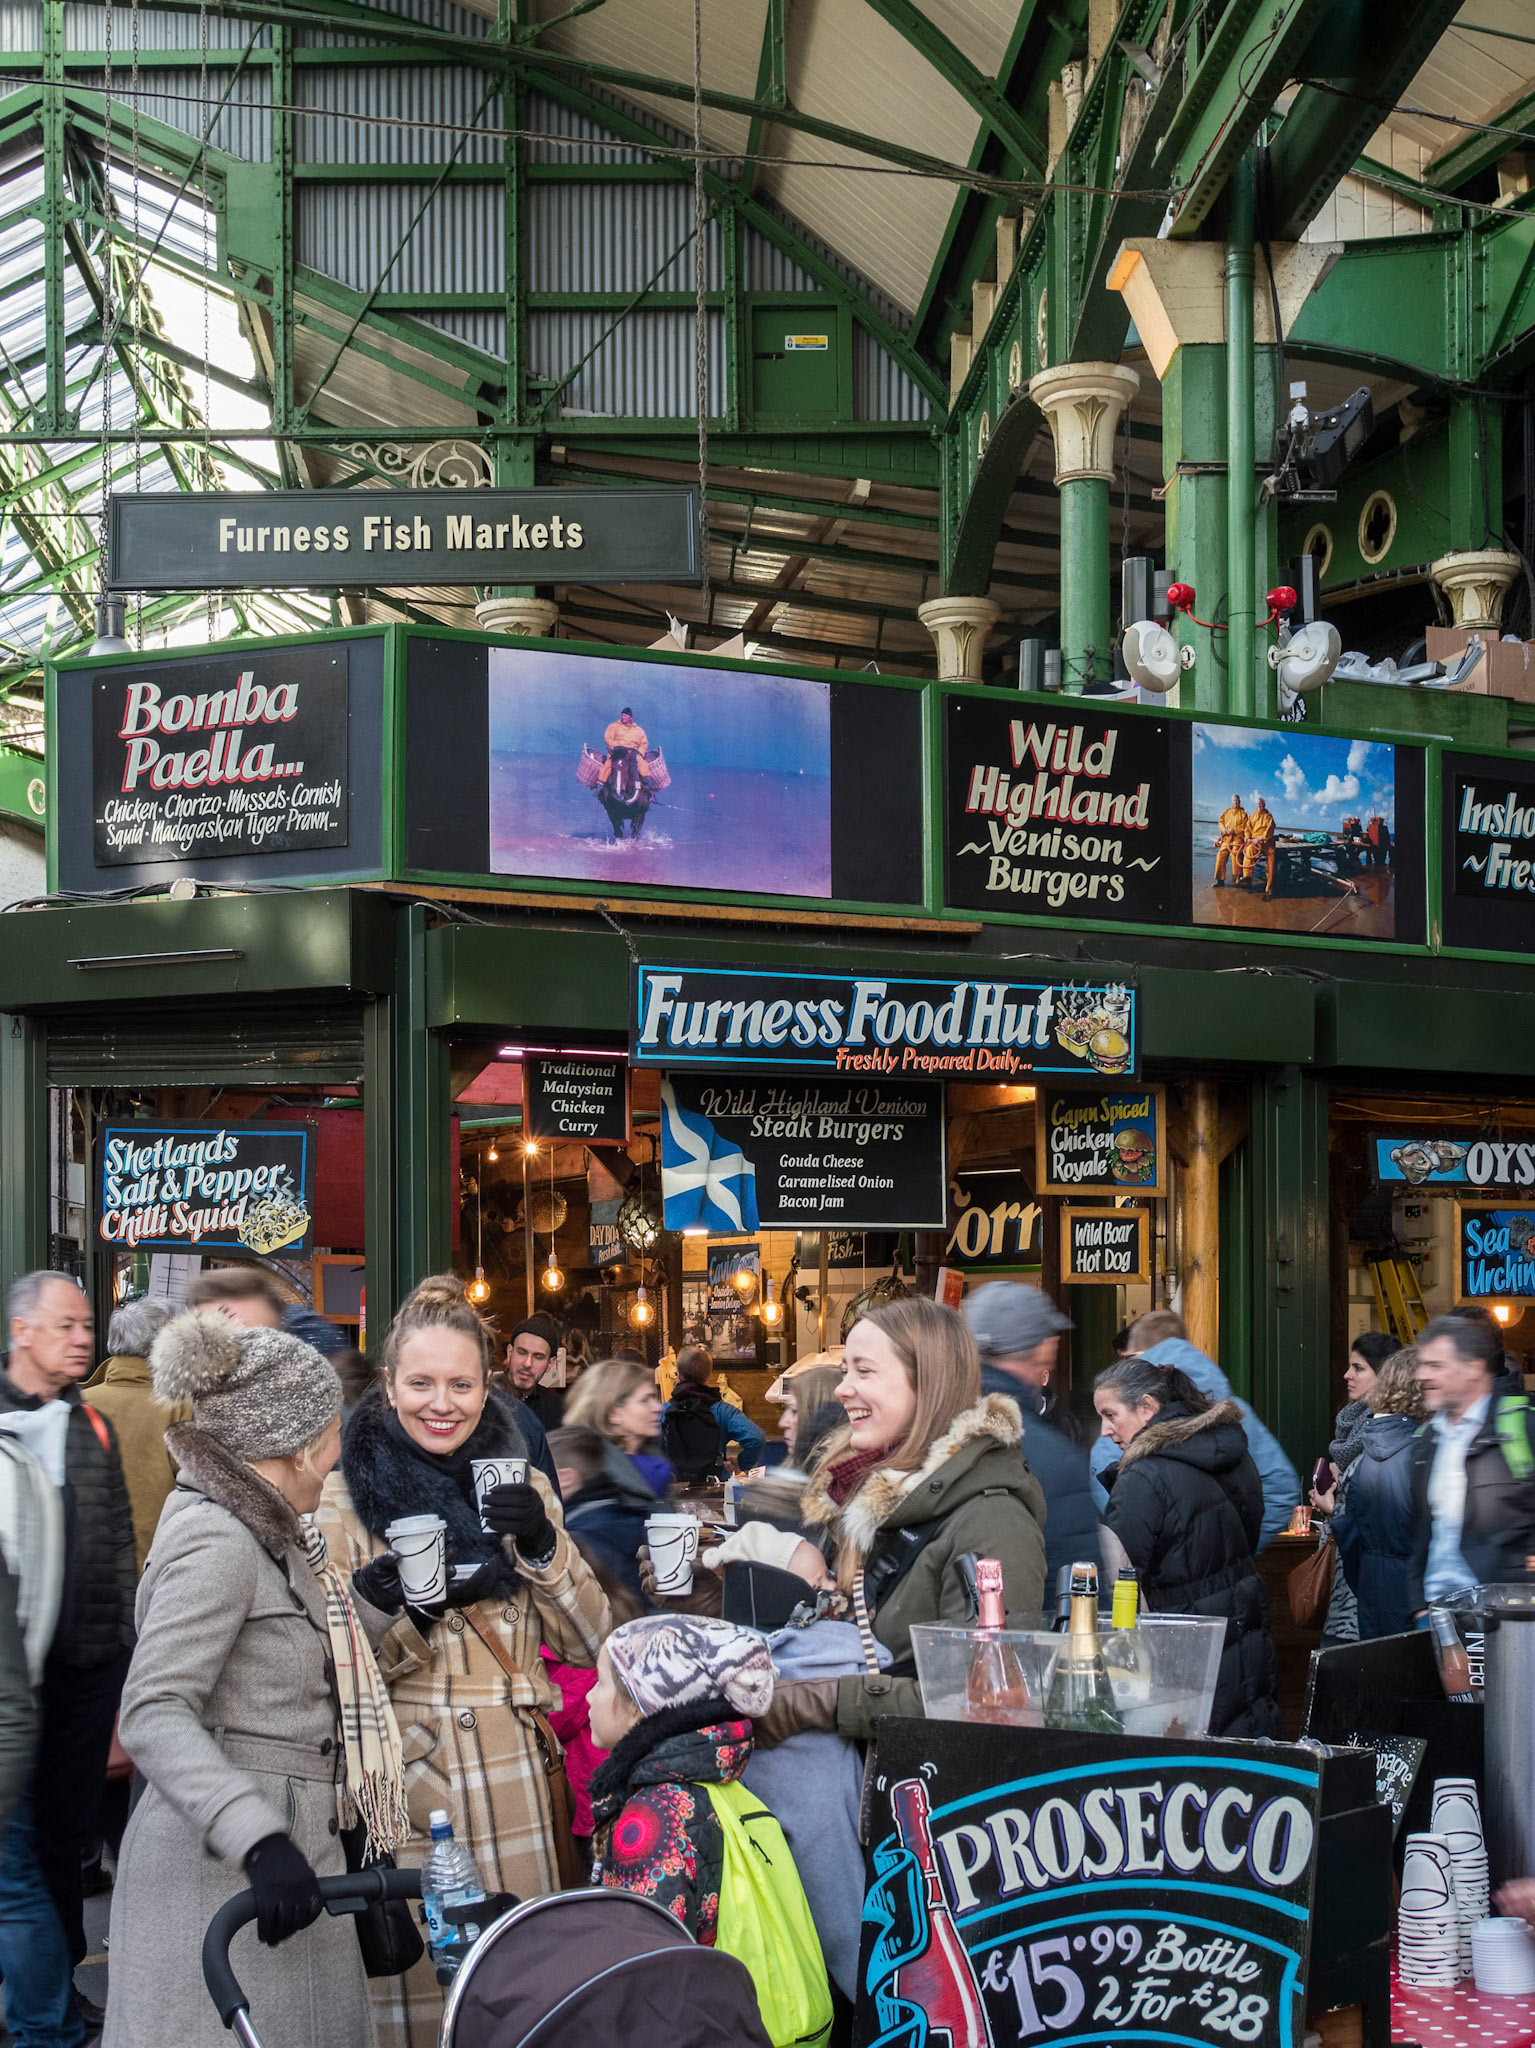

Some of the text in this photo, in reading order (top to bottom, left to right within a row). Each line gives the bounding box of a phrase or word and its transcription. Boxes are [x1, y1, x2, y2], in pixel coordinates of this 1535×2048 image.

[219, 514, 584, 552] Furness Fish Markets
[118, 671, 299, 738] Bomba
[121, 729, 304, 792] Paella...
[1009, 719, 1118, 777] Wild
[226, 785, 286, 813] Mussels
[291, 779, 342, 807] Cornish
[965, 764, 1150, 830] Highland
[107, 821, 143, 852] Squid
[151, 814, 243, 851] Madagaskan
[245, 812, 285, 845] Tiger
[988, 820, 1123, 866] Venison
[985, 856, 1125, 907] Burgers
[636, 975, 1054, 1049] Furness Food Hut
[540, 1061, 617, 1077] Traditional
[836, 1048, 1032, 1074] Freshly Prepared Daily...
[542, 1080, 613, 1098] Malaysian
[551, 1099, 605, 1115] Chicken
[700, 1088, 928, 1120] Wild Highland Venison
[559, 1118, 598, 1136] Curry
[750, 1114, 904, 1145] Steak Burgers
[1051, 1095, 1149, 1130] Cajun Spiced
[104, 1129, 240, 1178] Shetlands
[1050, 1126, 1115, 1152] Chicken
[779, 1154, 864, 1169] Gouda Cheese
[1052, 1152, 1108, 1182] Royale
[1466, 1141, 1535, 1185] OYS
[104, 1164, 286, 1208] Salt & Pepper
[778, 1174, 894, 1189] Caramelised Onion
[778, 1194, 844, 1211] Bacon Jam
[100, 1195, 249, 1247] Chilli Squid
[589, 1224, 604, 1246] DAY
[1075, 1221, 1134, 1247] Wild Boar
[1465, 1218, 1510, 1259] Sea
[828, 1238, 863, 1260] Fish...
[1076, 1249, 1131, 1273] Hot Dog
[1467, 1254, 1535, 1297] Urchin
[935, 1781, 1314, 1919] PROSECCO
[1137, 1924, 1263, 1983] Bottle
[1092, 1975, 1122, 2023] 2
[1189, 1981, 1269, 2042] £28
